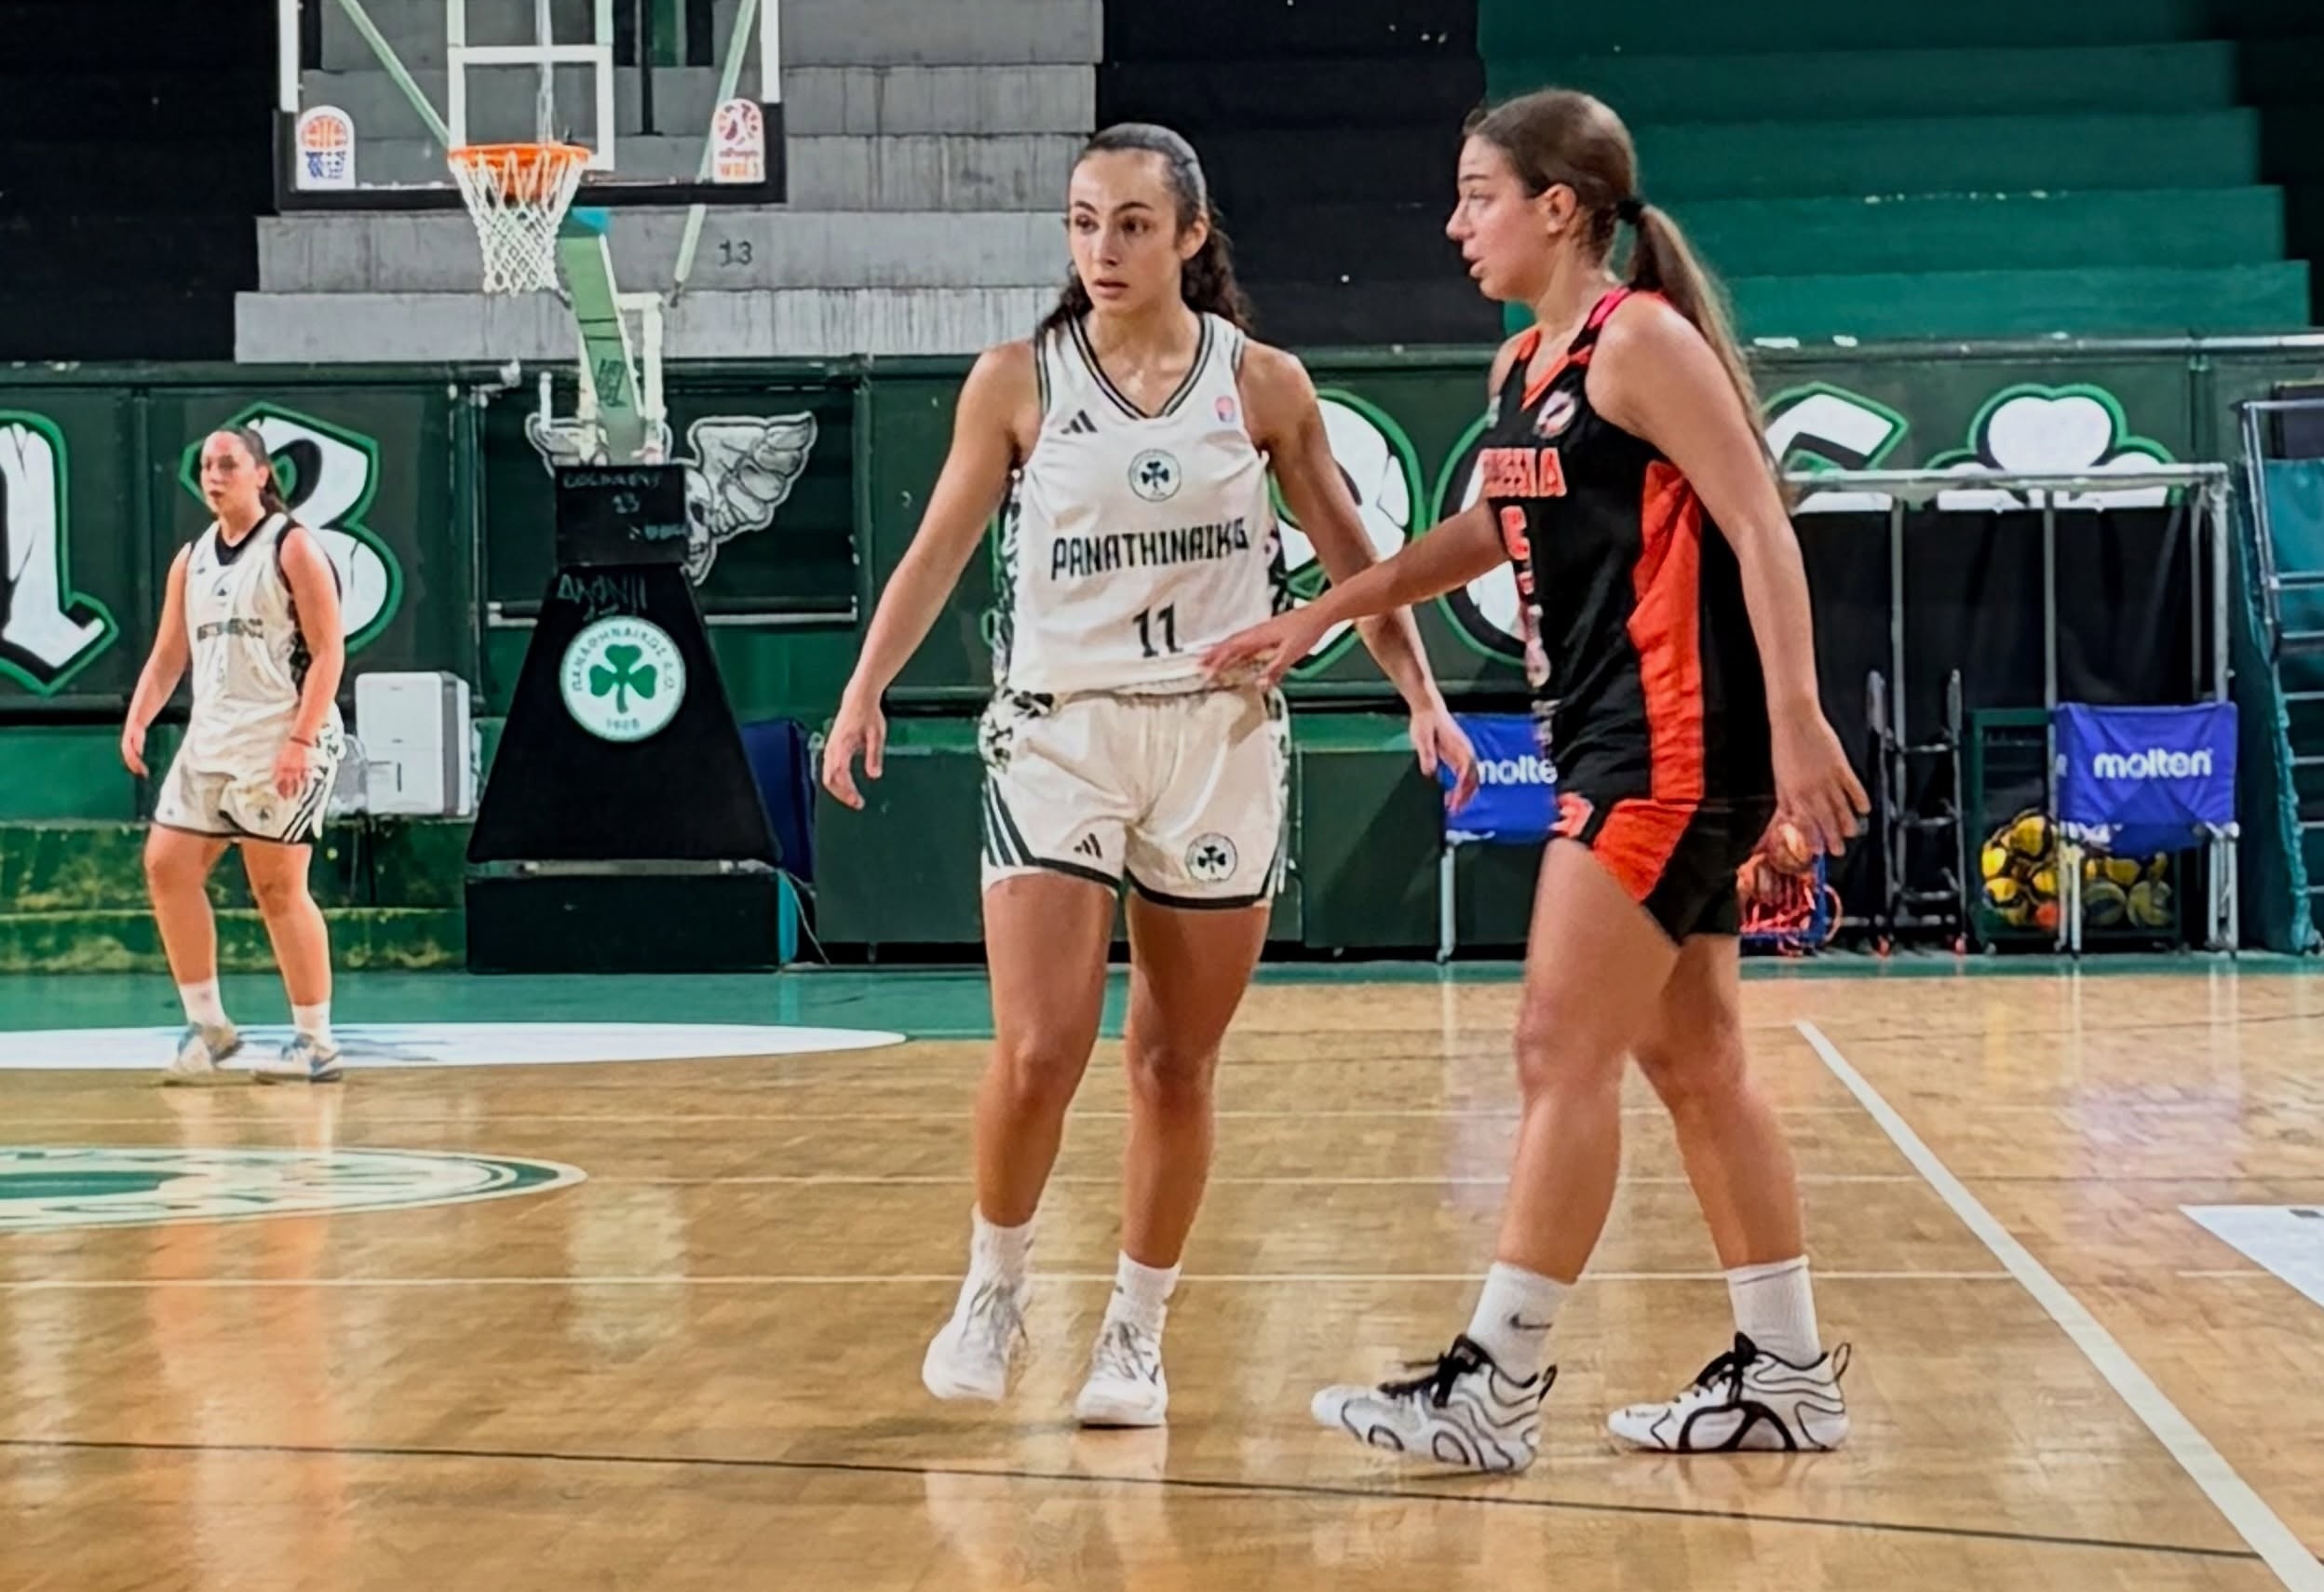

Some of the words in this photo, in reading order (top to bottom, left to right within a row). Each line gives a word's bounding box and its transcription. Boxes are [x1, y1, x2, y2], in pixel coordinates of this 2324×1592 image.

[718, 238, 753, 268] 13
[1131, 601, 1184, 658] 11
[1477, 754, 1559, 785] molte
[2093, 748, 2213, 779] molten
